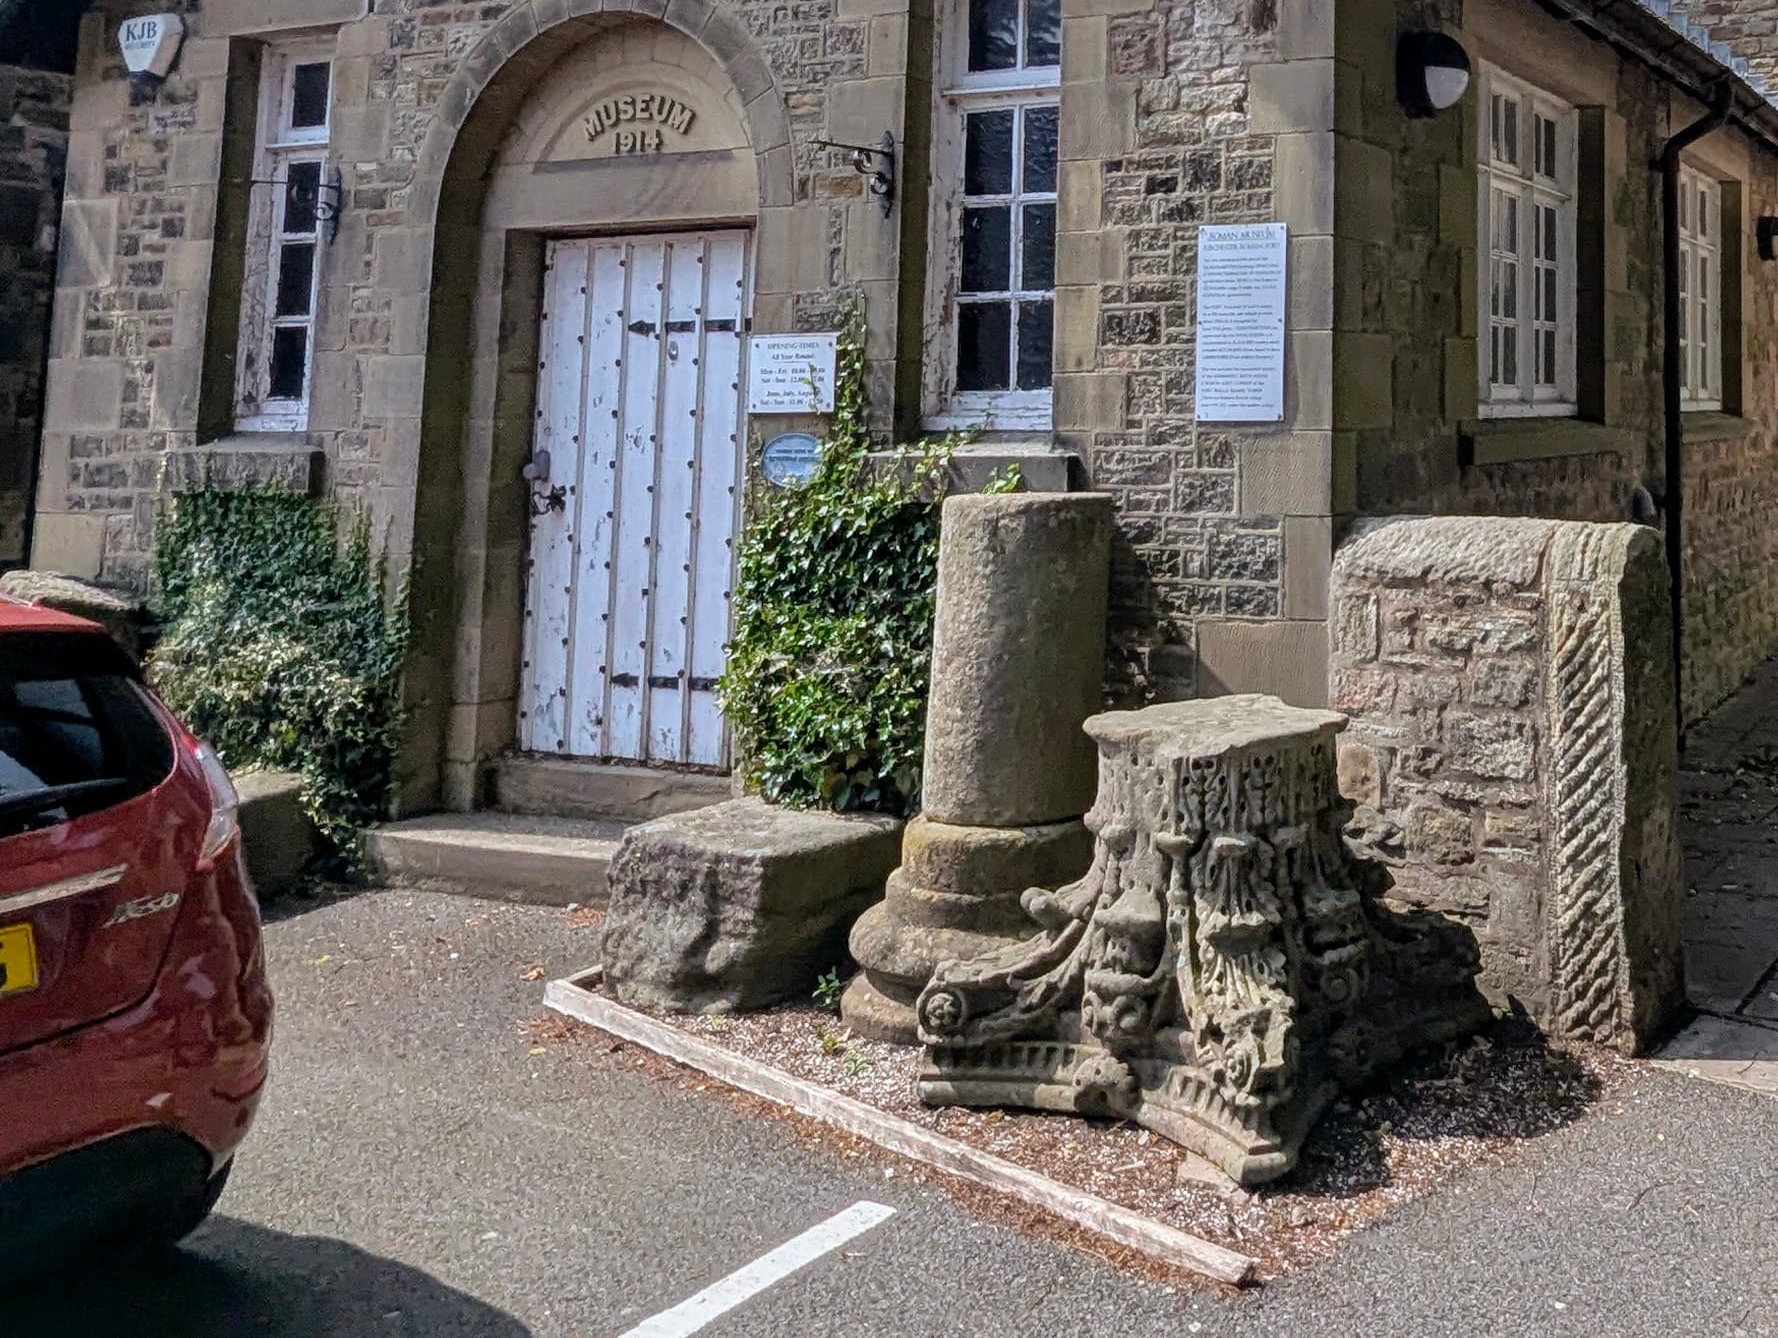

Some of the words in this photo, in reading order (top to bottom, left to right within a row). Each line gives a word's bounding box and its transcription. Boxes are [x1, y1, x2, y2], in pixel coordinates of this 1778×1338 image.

[126, 21, 157, 41] KJB
[583, 94, 696, 141] MUSEUM
[613, 129, 664, 153] 1914
[767, 342, 797, 350] OPENING
